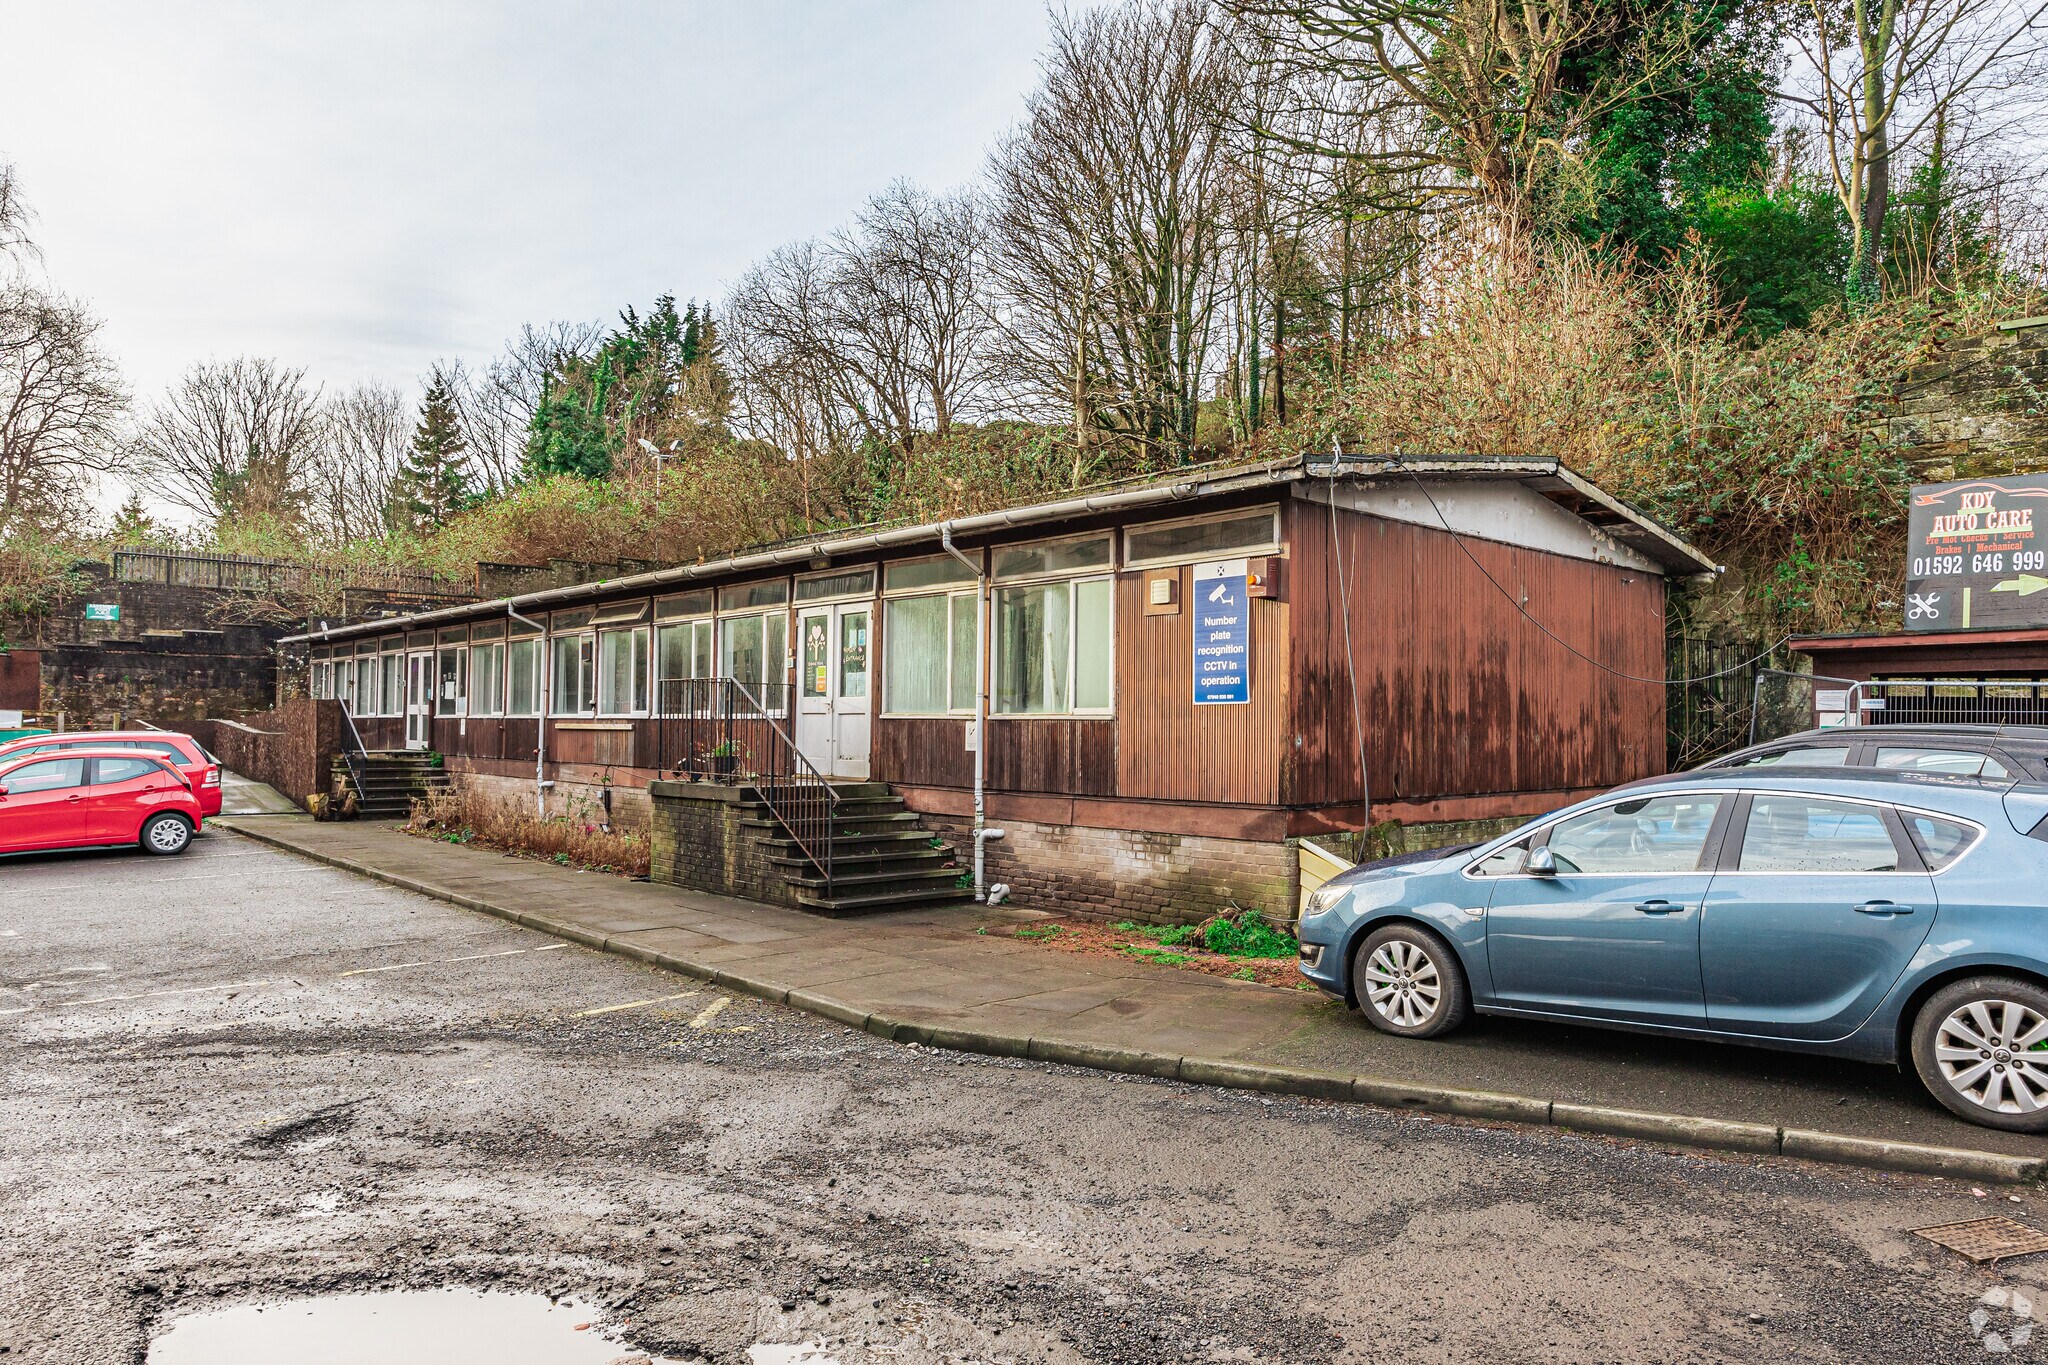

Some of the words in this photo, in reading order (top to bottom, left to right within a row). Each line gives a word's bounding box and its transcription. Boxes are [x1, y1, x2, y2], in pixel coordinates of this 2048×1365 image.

[1961, 491, 1996, 510] KDY
[1933, 513, 1978, 533] AUTO
[1986, 509, 2033, 529] CARE
[1961, 533, 1989, 543] Checks
[2003, 531, 2035, 540] Service
[1935, 545, 1962, 555] Brakes
[1976, 541, 2023, 553] Mechanical
[1914, 556, 1962, 576] 01592
[1972, 553, 2003, 573] 646
[2012, 550, 2045, 571] 999
[1204, 616, 1238, 627] Number
[1210, 630, 1231, 642] plate
[1198, 645, 1243, 656] recognition
[1204, 661, 1227, 671] CCTV
[1229, 661, 1237, 670] in
[1201, 675, 1241, 687] operation
